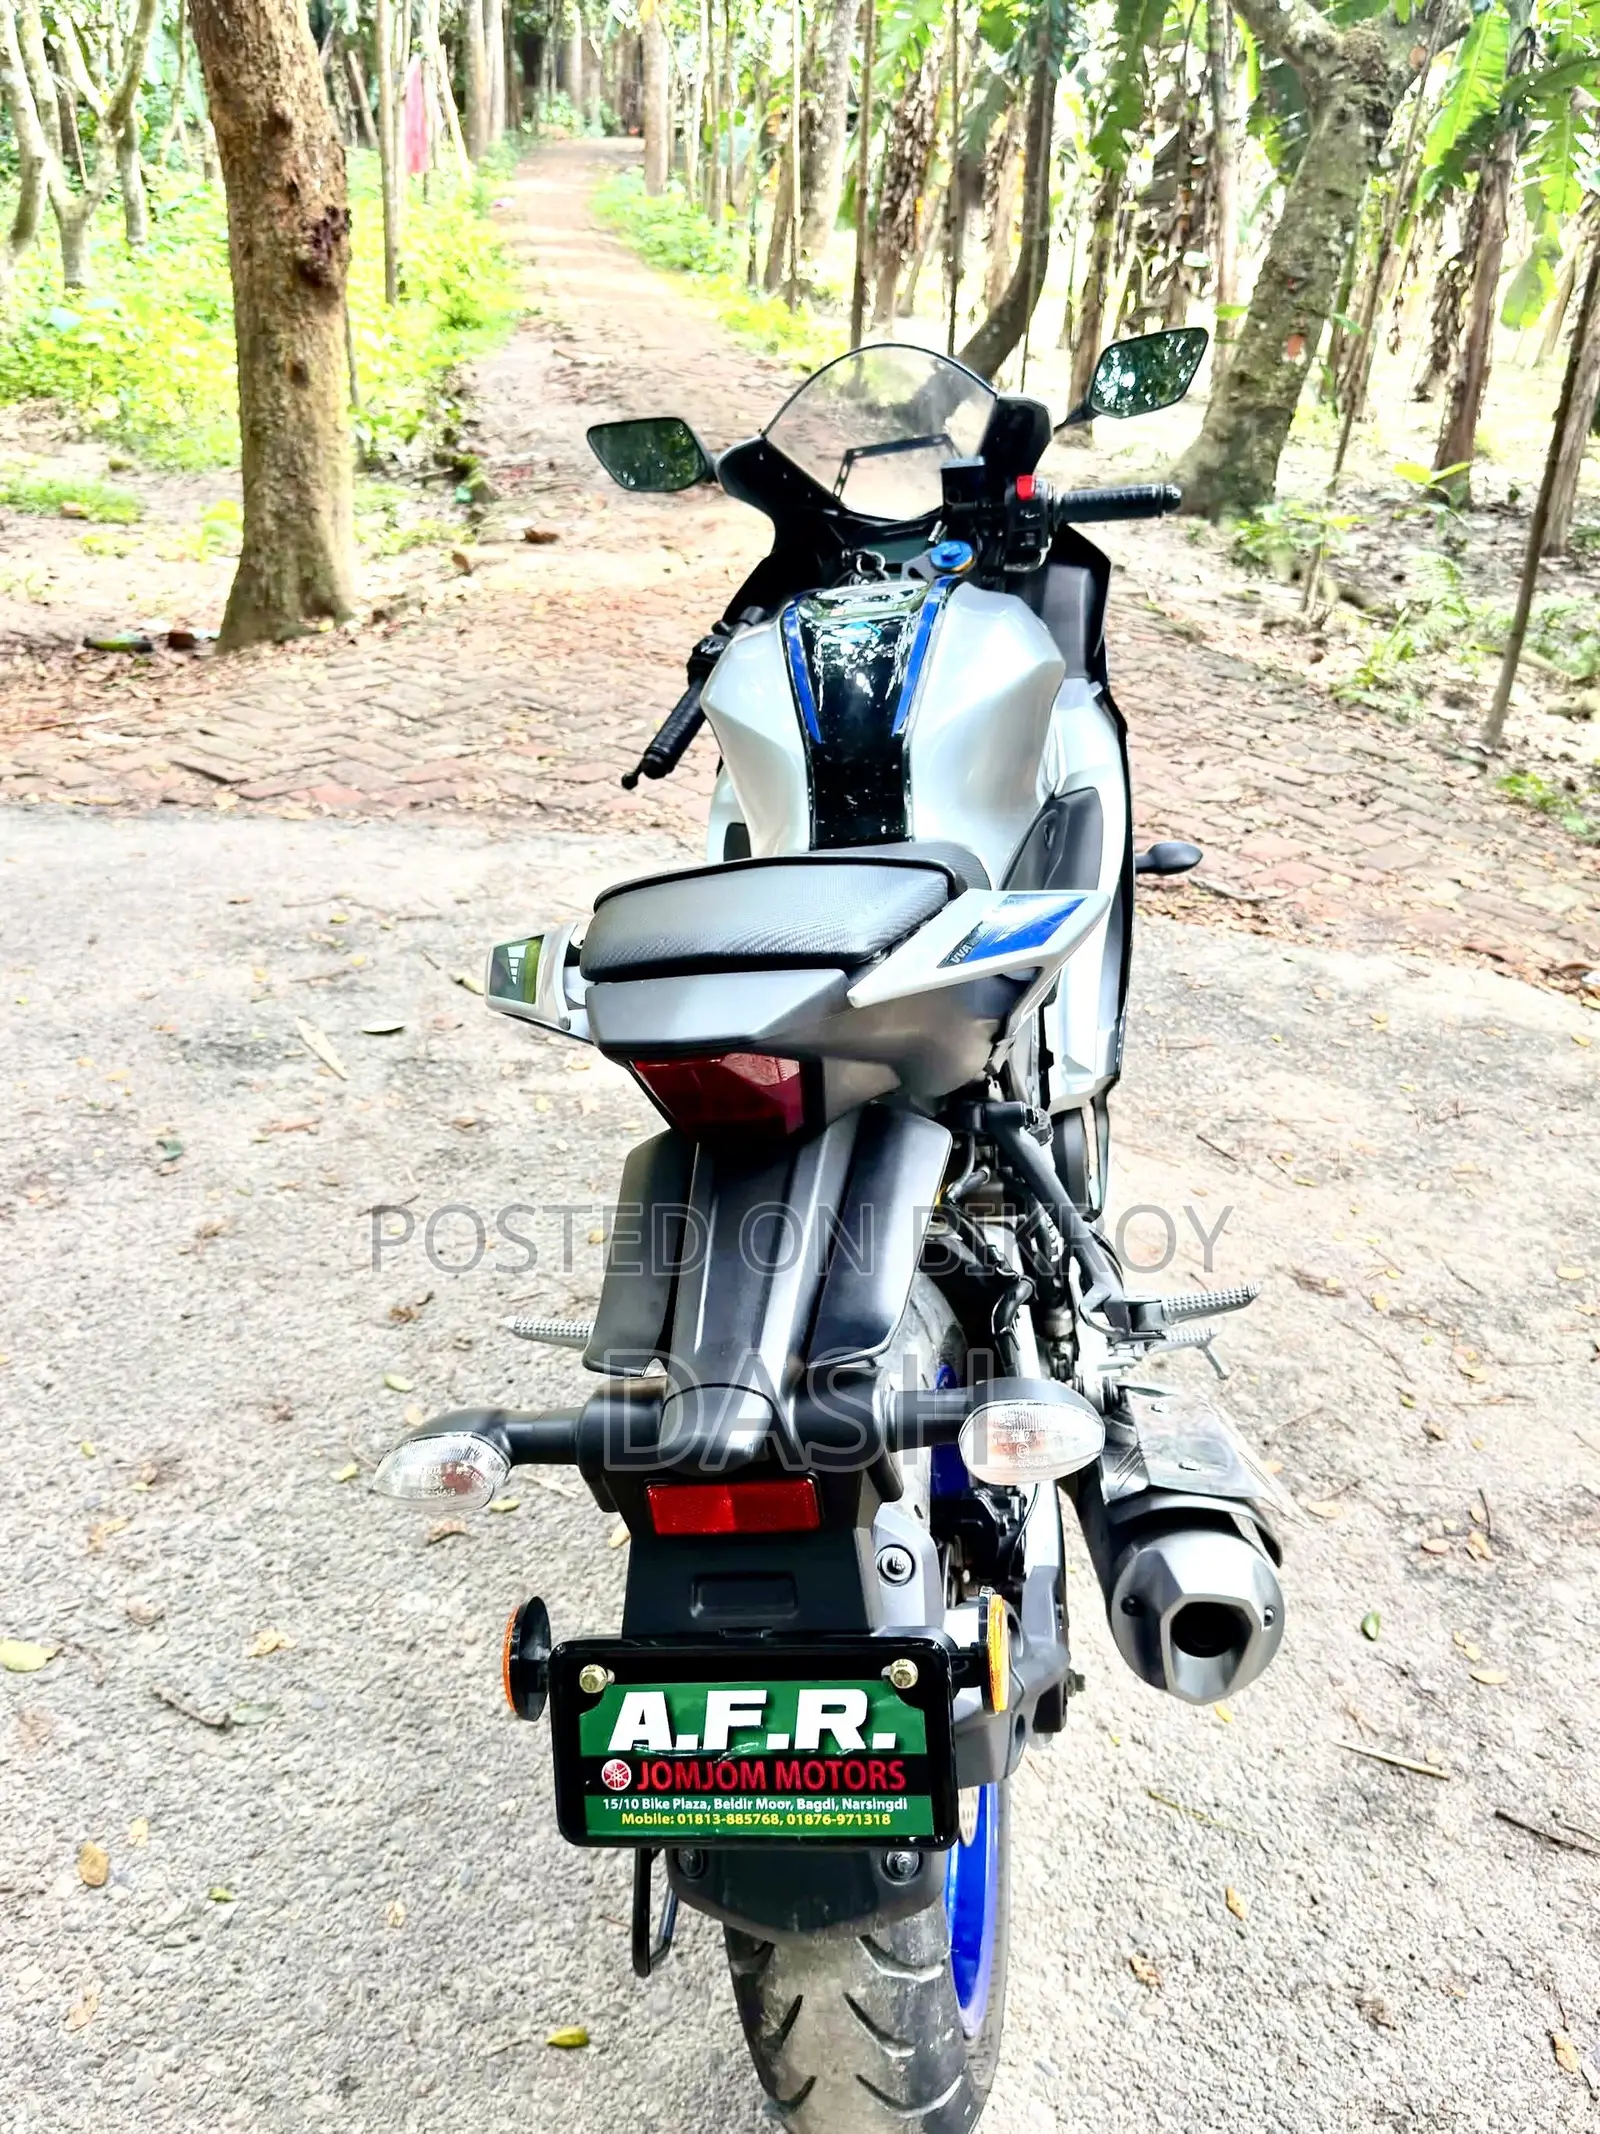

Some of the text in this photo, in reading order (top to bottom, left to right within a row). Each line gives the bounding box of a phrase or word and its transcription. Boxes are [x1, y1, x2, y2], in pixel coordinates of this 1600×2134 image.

[607, 1688, 897, 1752] A.F.R.
[637, 1759, 907, 1792] JOMJOM MOTORS
[603, 1797, 639, 1810] 15/10
[641, 1797, 670, 1810] Bike
[672, 1797, 711, 1811] Plaza,
[755, 1797, 794, 1811] Moor,
[796, 1797, 839, 1812] Bagdi,
[842, 1796, 908, 1812] Narsingdi
[621, 1812, 891, 1826] Mobile: 01813-885768, 01876-971318
